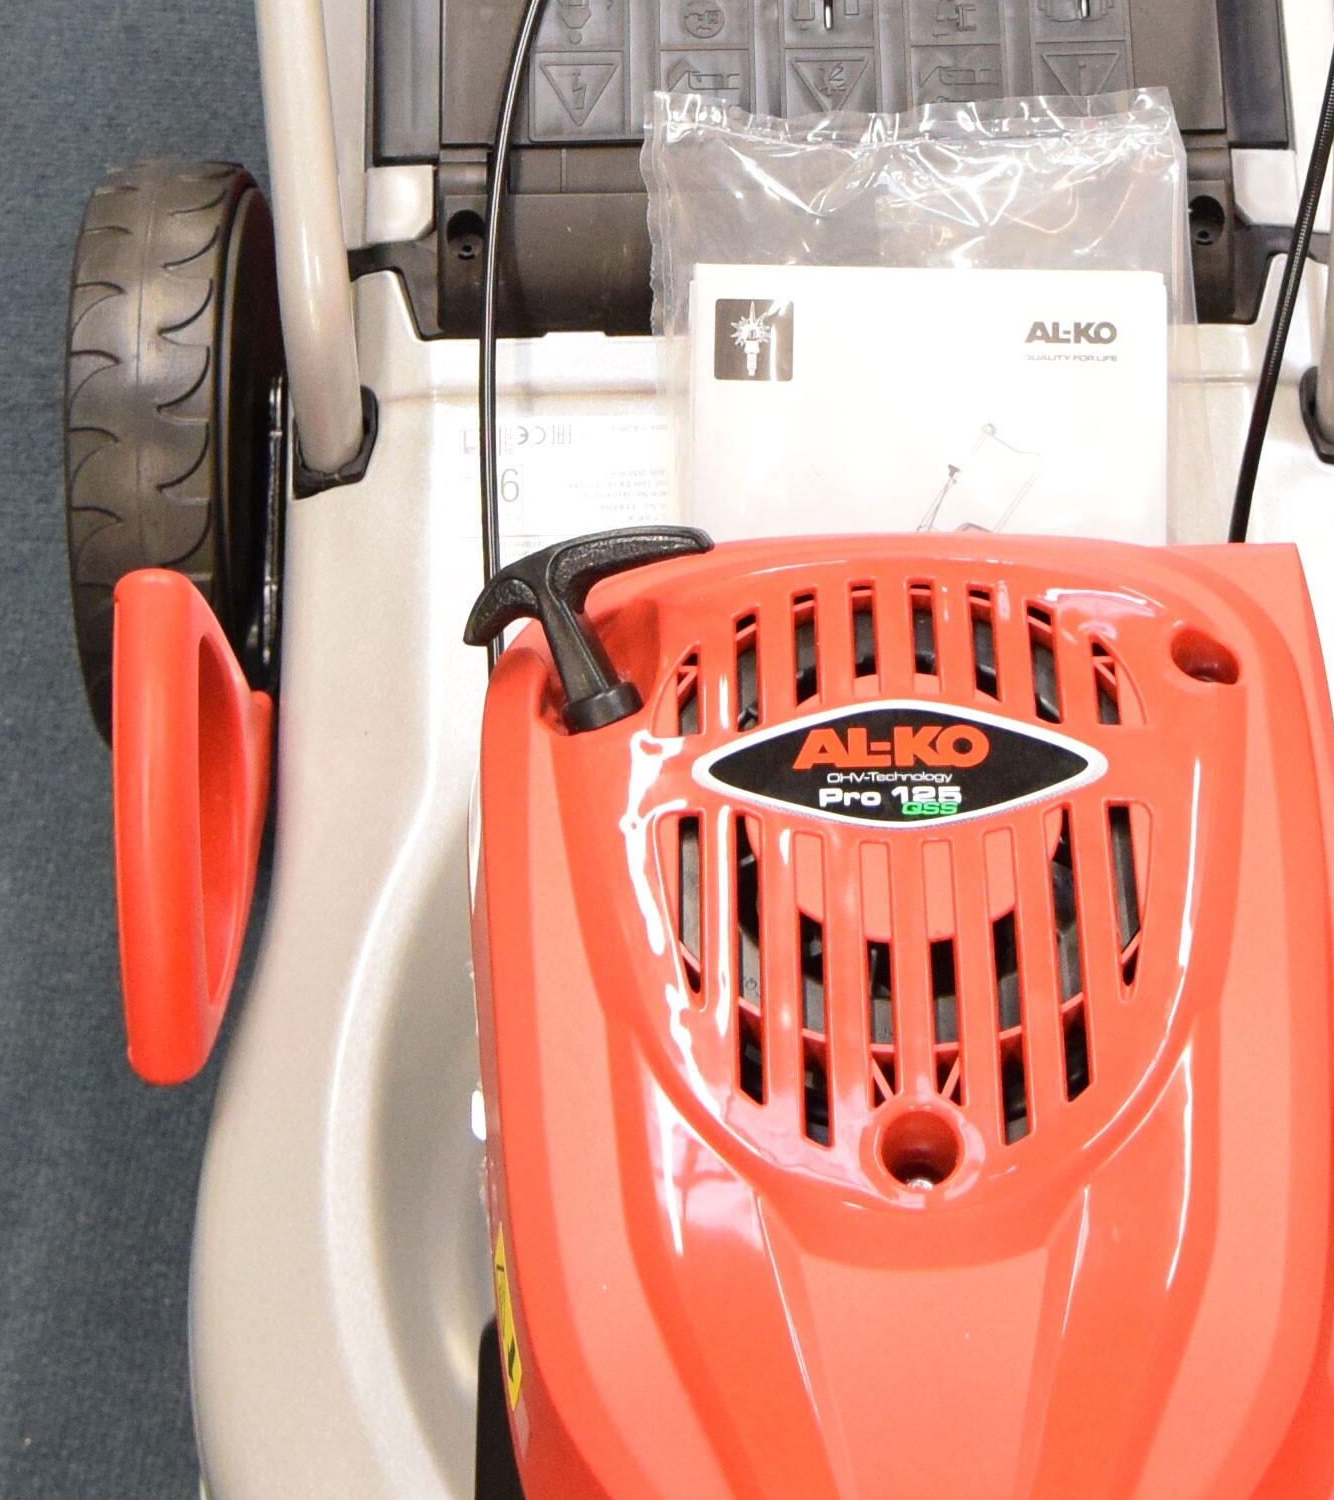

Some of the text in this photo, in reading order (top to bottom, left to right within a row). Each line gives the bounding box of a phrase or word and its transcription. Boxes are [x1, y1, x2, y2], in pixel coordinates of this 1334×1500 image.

[1025, 321, 1118, 345] AL-KO
[1073, 354, 1095, 362] FOR
[1097, 354, 1118, 362] LIFE
[792, 724, 990, 770] AL-KO
[826, 771, 953, 784] OHV-Technology
[818, 785, 963, 808] Pro 125
[901, 801, 959, 816] QSS
